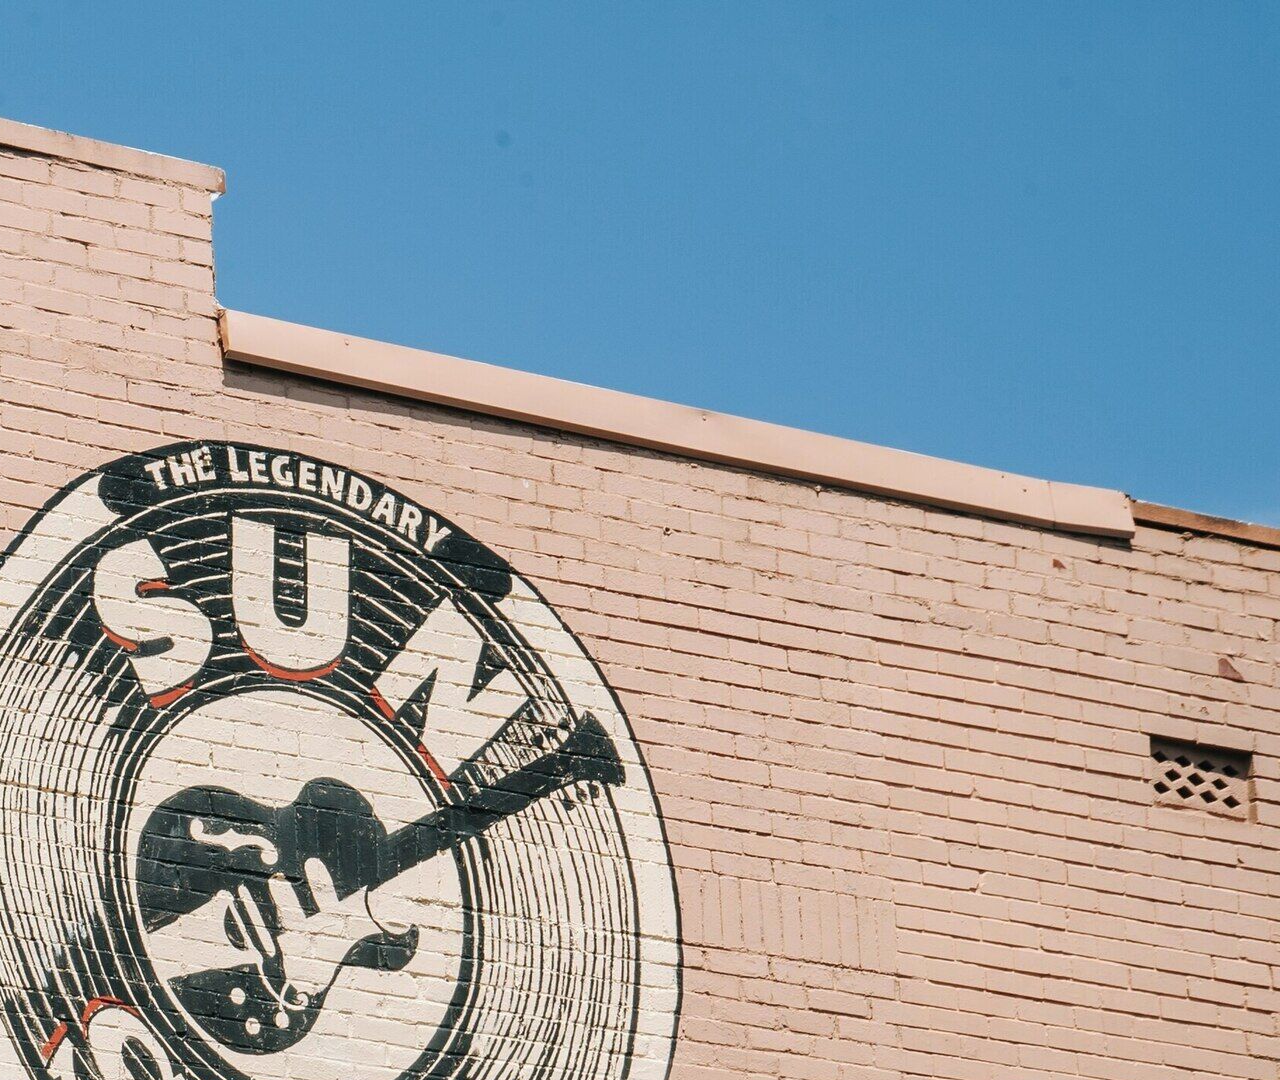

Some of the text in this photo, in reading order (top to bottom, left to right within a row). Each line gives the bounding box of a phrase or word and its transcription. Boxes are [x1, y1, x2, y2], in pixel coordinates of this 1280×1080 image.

[144, 446, 452, 552] THE LEGENDARY
[92, 516, 531, 789] SUN
